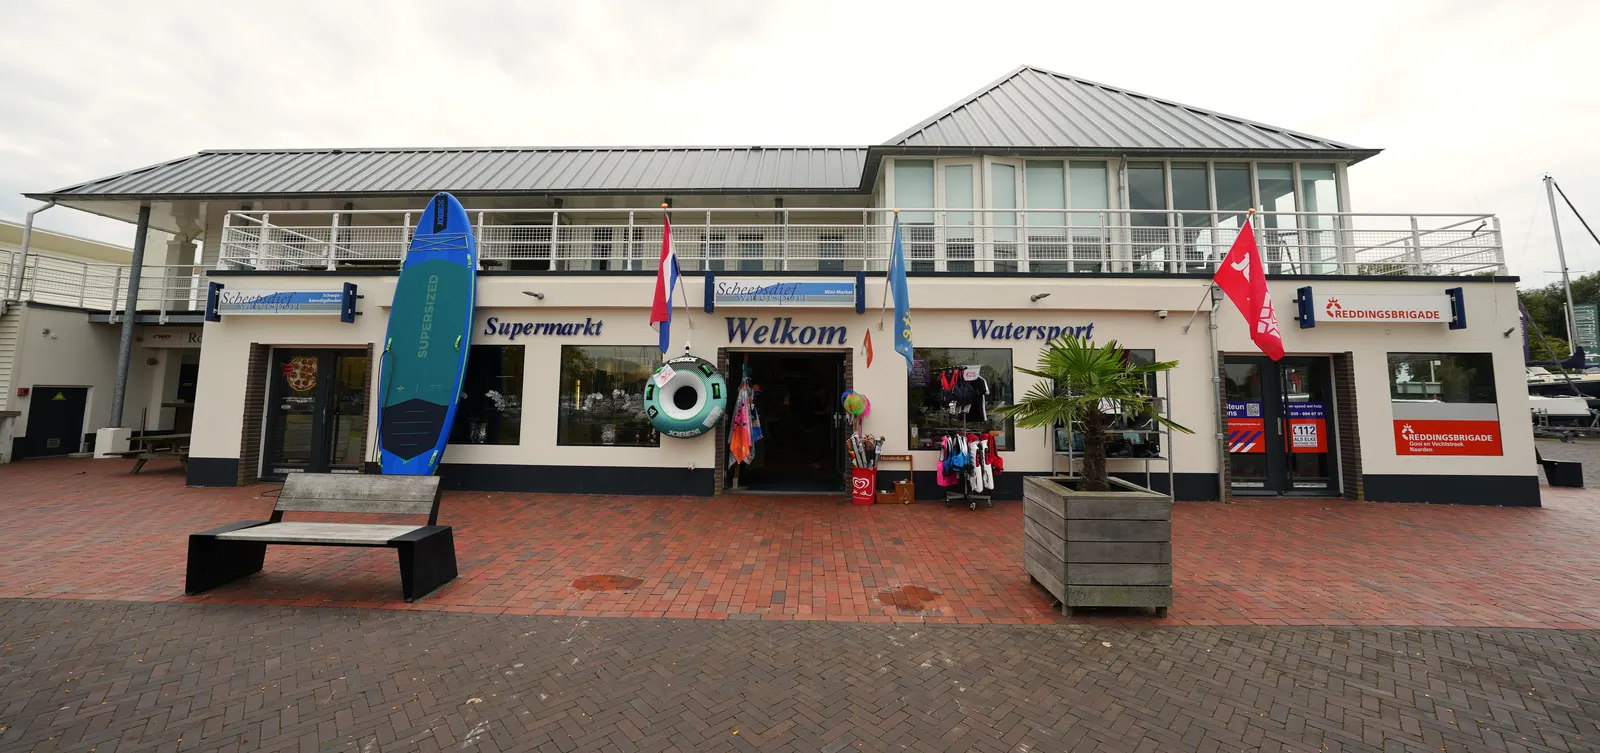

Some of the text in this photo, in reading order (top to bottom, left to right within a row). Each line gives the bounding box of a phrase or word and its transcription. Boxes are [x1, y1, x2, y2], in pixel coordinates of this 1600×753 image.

[716, 281, 802, 300] Scheepsdief
[220, 291, 297, 308] Scheepsdief
[239, 302, 300, 313] watersport
[736, 294, 807, 306] watersport
[418, 274, 438, 359] SUPERSIZED
[1335, 310, 1440, 319] REDDINGSBRIGADE
[484, 317, 603, 340] Supermarkt
[724, 316, 847, 345] Welkom
[970, 319, 1095, 345] Watersport
[1298, 426, 1316, 435] 112
[1409, 433, 1493, 442] REDDINGSBRIGADE
